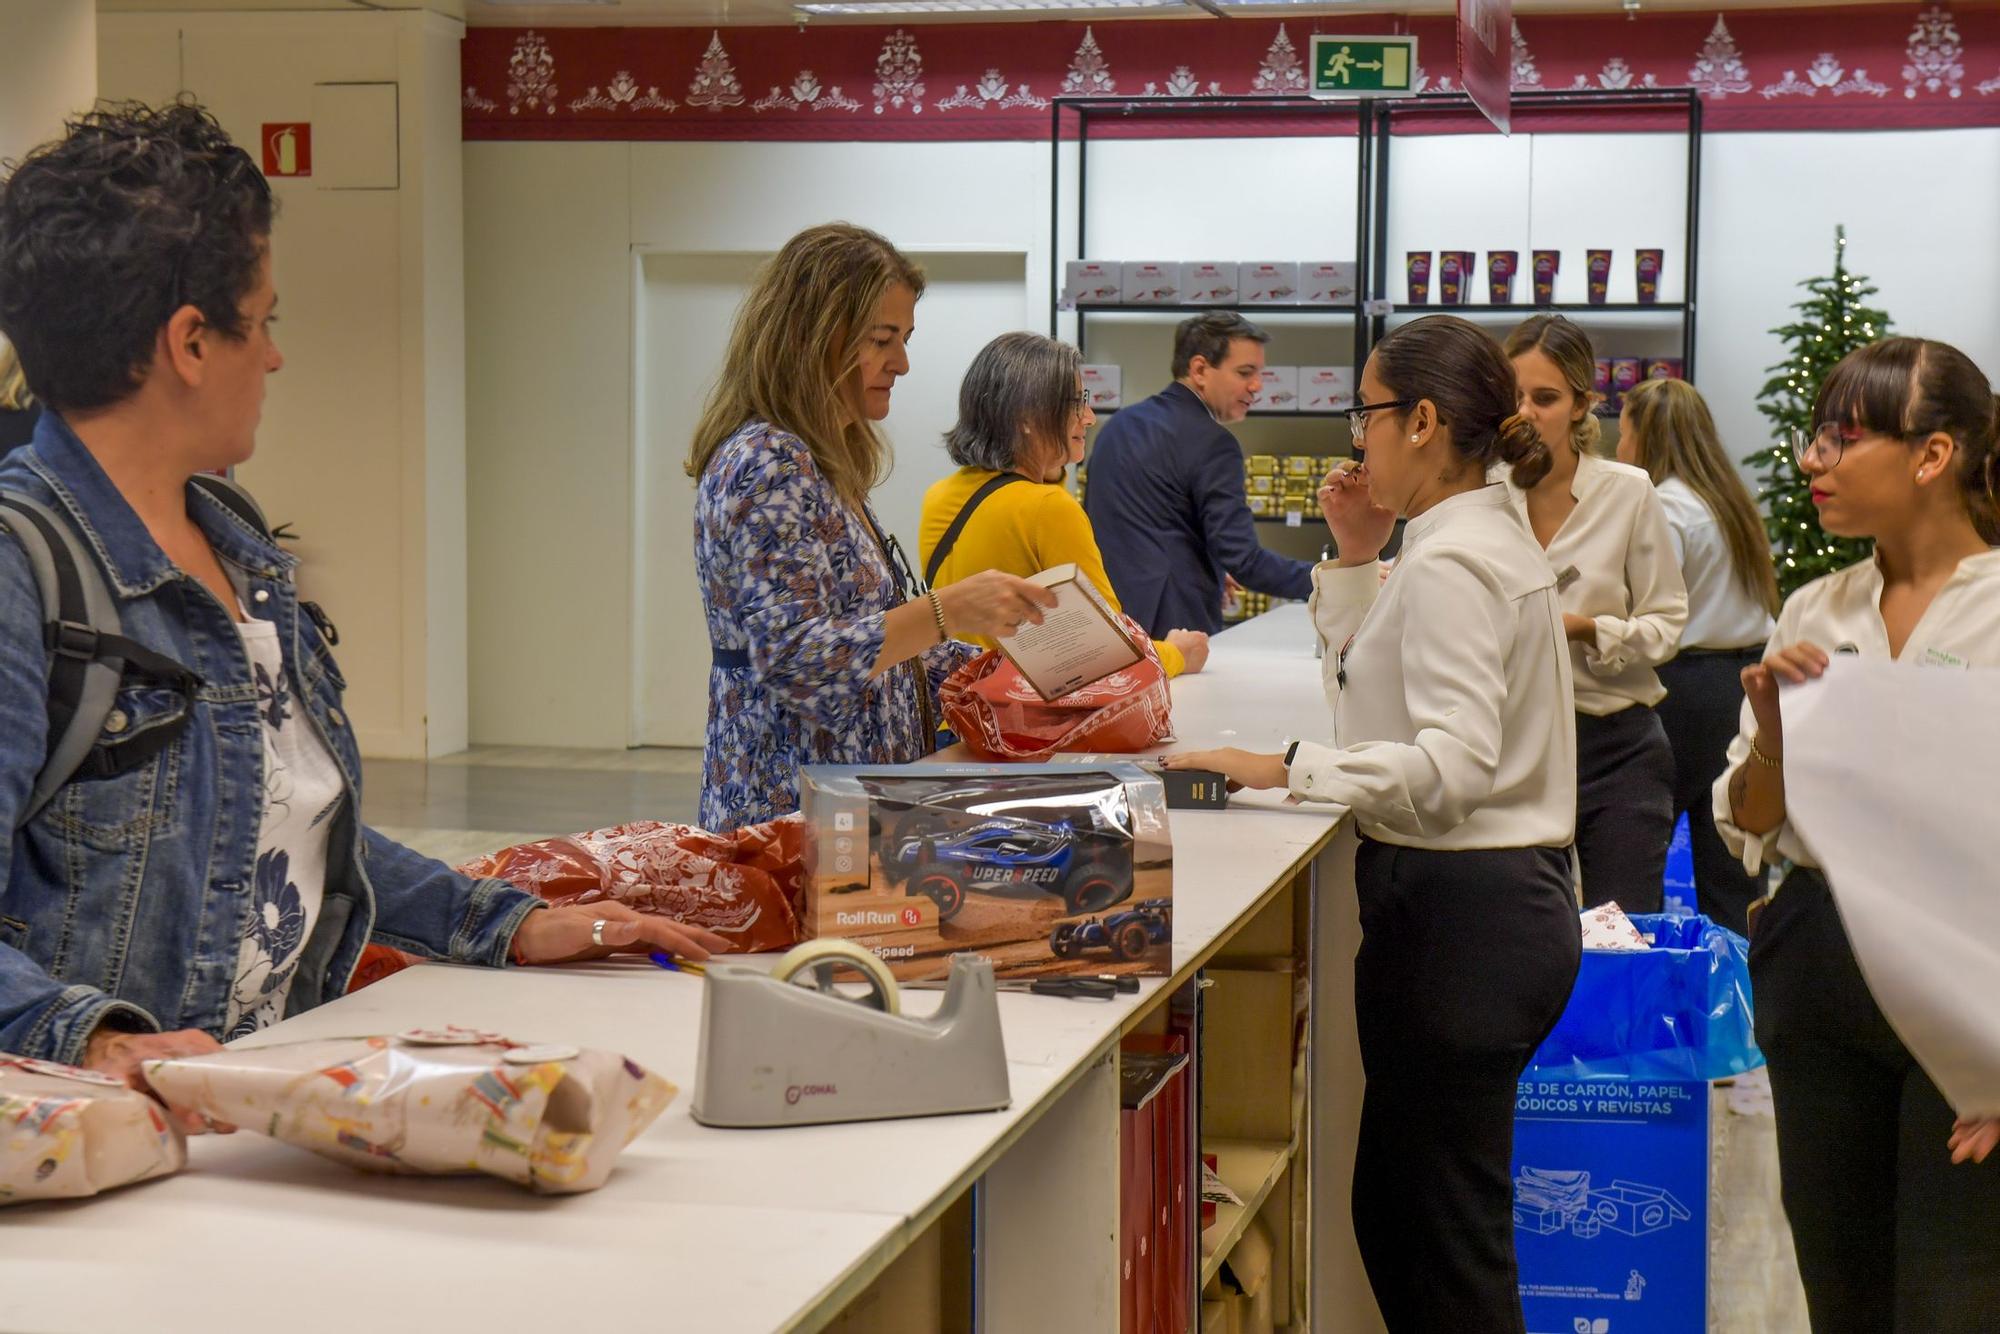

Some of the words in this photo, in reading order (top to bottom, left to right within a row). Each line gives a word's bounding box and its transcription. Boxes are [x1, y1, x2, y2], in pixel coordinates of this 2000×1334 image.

[837, 911, 864, 925] Roll
[867, 911, 896, 925] Run
[870, 944, 914, 960] Speed
[1538, 1083, 1559, 1095] DE
[1564, 1082, 1634, 1099] CARTÓN,
[1638, 1086, 1691, 1101] PAPEL,
[1582, 1100, 1593, 1112] Y
[1597, 1100, 1673, 1114] REVISTAS
